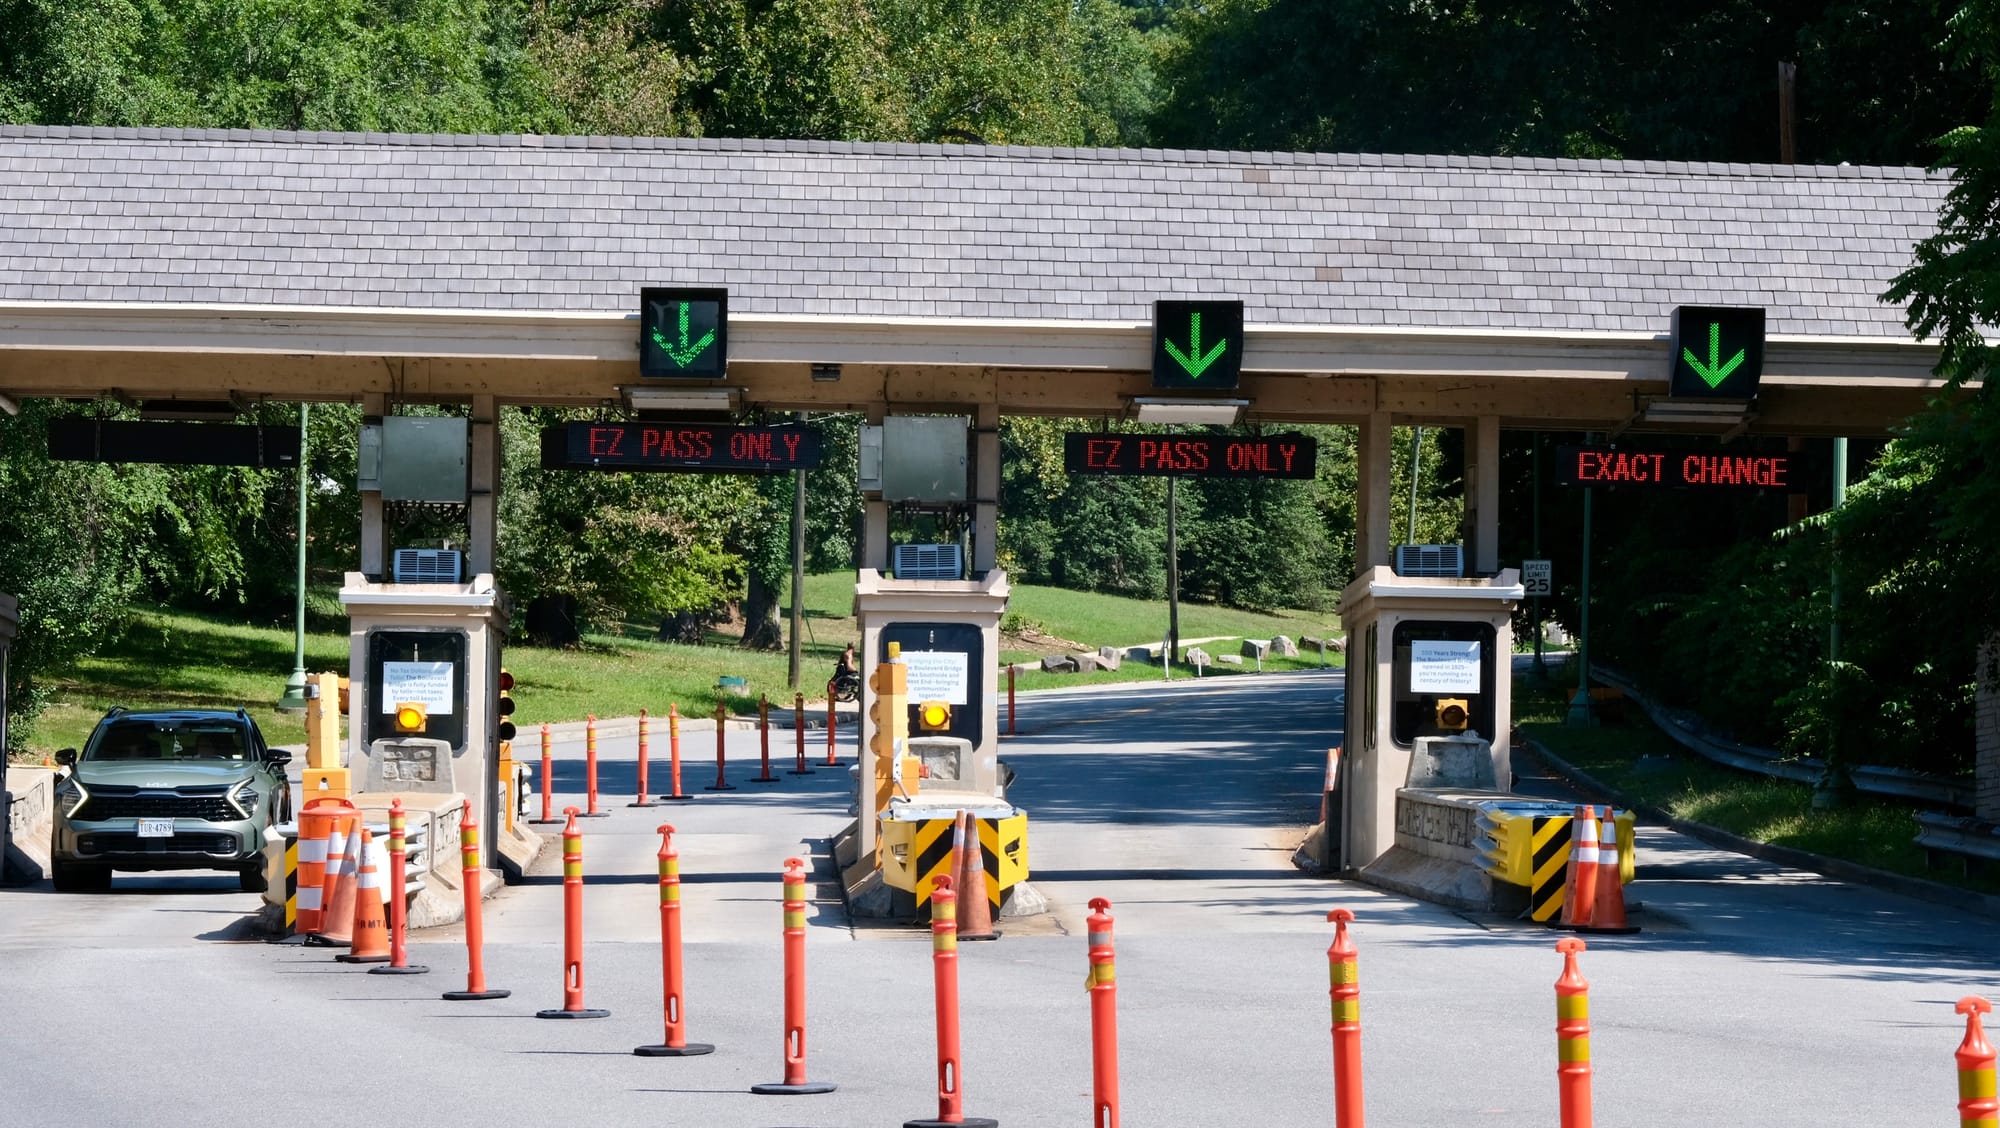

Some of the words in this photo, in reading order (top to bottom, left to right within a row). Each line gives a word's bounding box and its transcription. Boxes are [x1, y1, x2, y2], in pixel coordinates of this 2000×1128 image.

[590, 427, 625, 456] EZ
[642, 429, 712, 458] PASS
[730, 432, 800, 461] ONLY
[1087, 440, 1122, 468] EZ
[1140, 441, 1209, 470] PASS
[1228, 443, 1296, 472] ONLY
[1578, 452, 1664, 482] EXACT
[1683, 455, 1786, 486] CHANGE
[1526, 578, 1549, 592] 25
